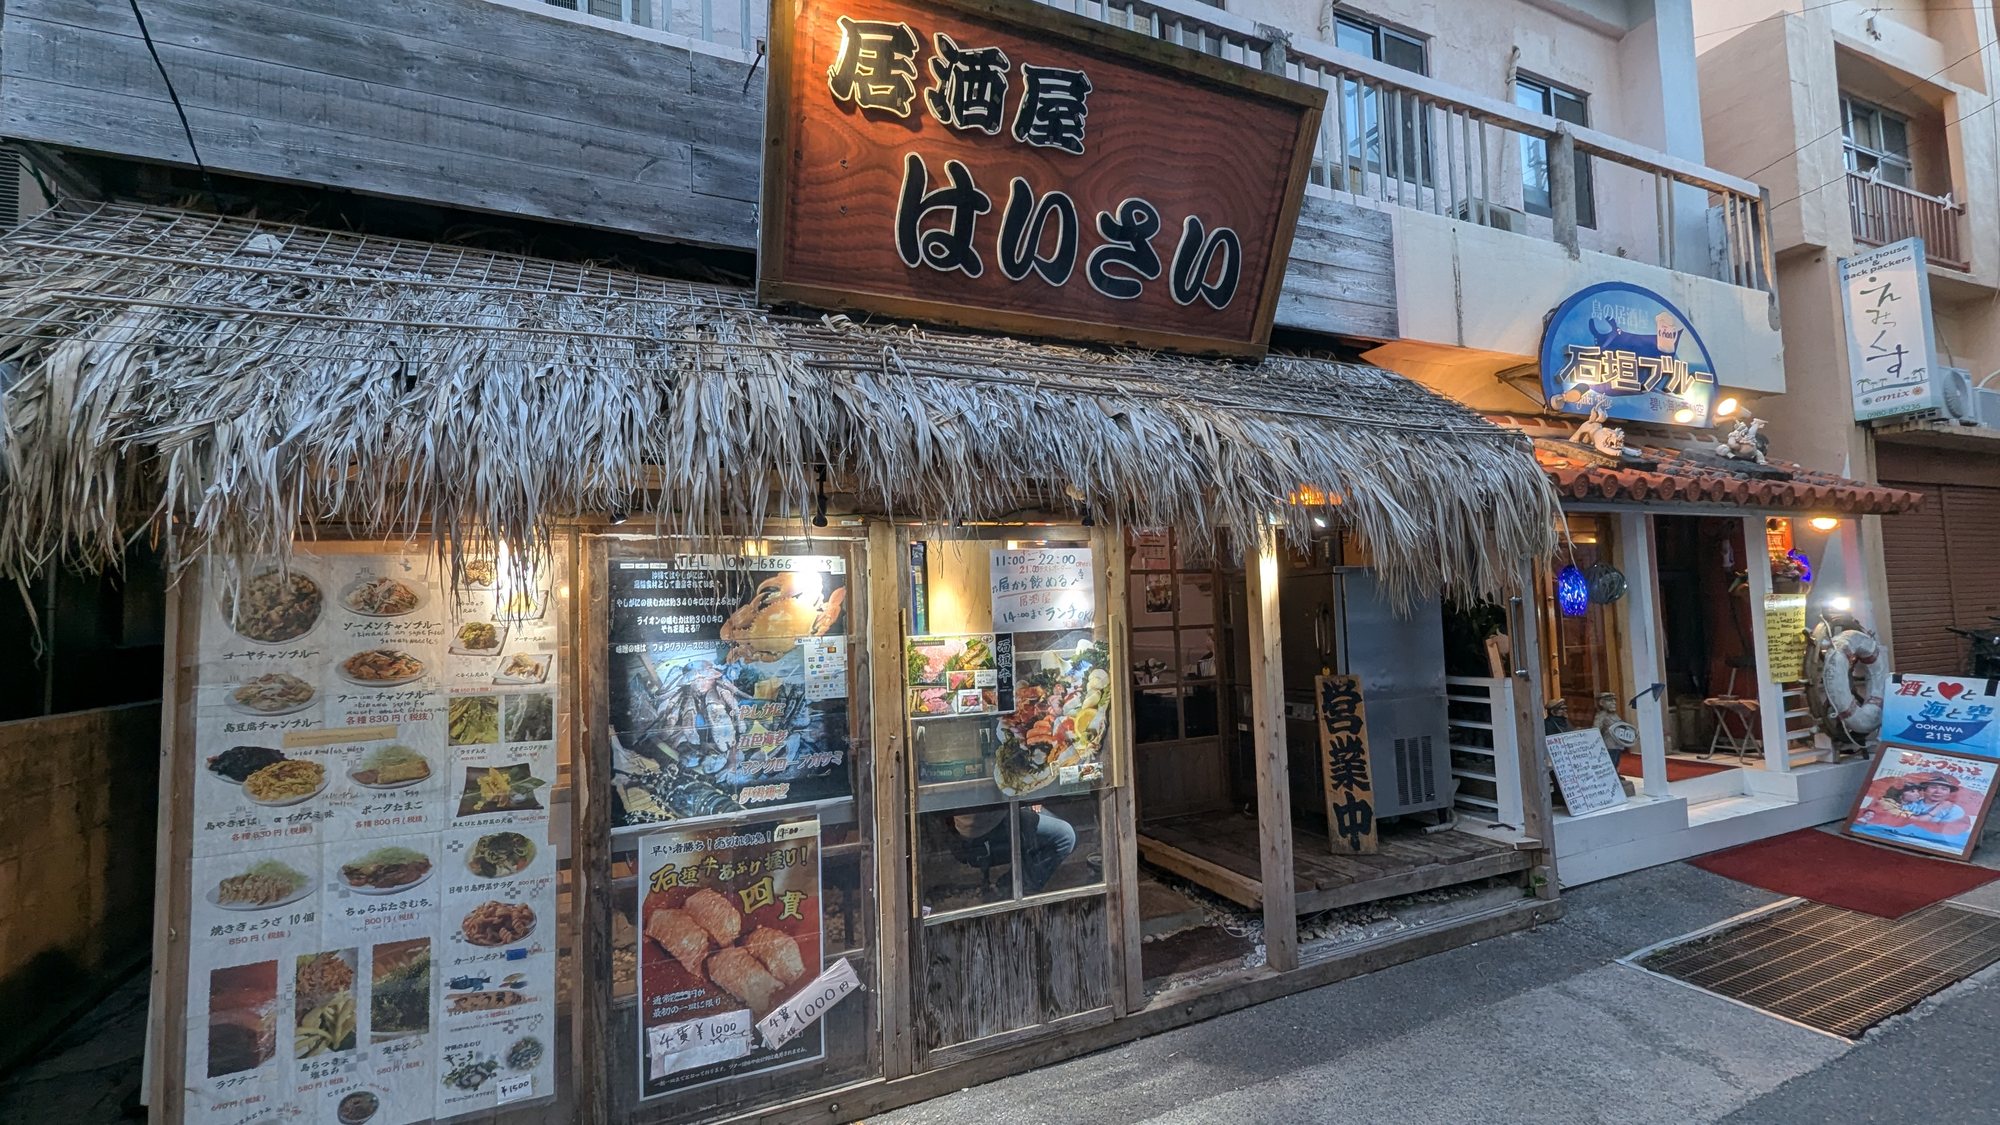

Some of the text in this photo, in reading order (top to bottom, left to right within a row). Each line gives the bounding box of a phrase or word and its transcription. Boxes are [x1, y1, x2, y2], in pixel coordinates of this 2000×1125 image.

[828, 15, 1093, 155] 居酒屋
[895, 151, 1242, 310] はいさい
[1843, 243, 1910, 270] Guest house
[1843, 254, 1913, 282] Back packers
[1871, 258, 1881, 266] &
[1859, 276, 1909, 379] えみっくす
[1559, 343, 1714, 395] 石垣ブルー
[1875, 389, 1911, 403] emix
[738, 702, 786, 720] やしがに
[1918, 700, 1995, 721] 海と空
[1915, 723, 1964, 734] OOKAWA
[1925, 731, 1953, 741] 215
[1320, 679, 1375, 851] 営業中
[738, 876, 808, 921] 四貫
